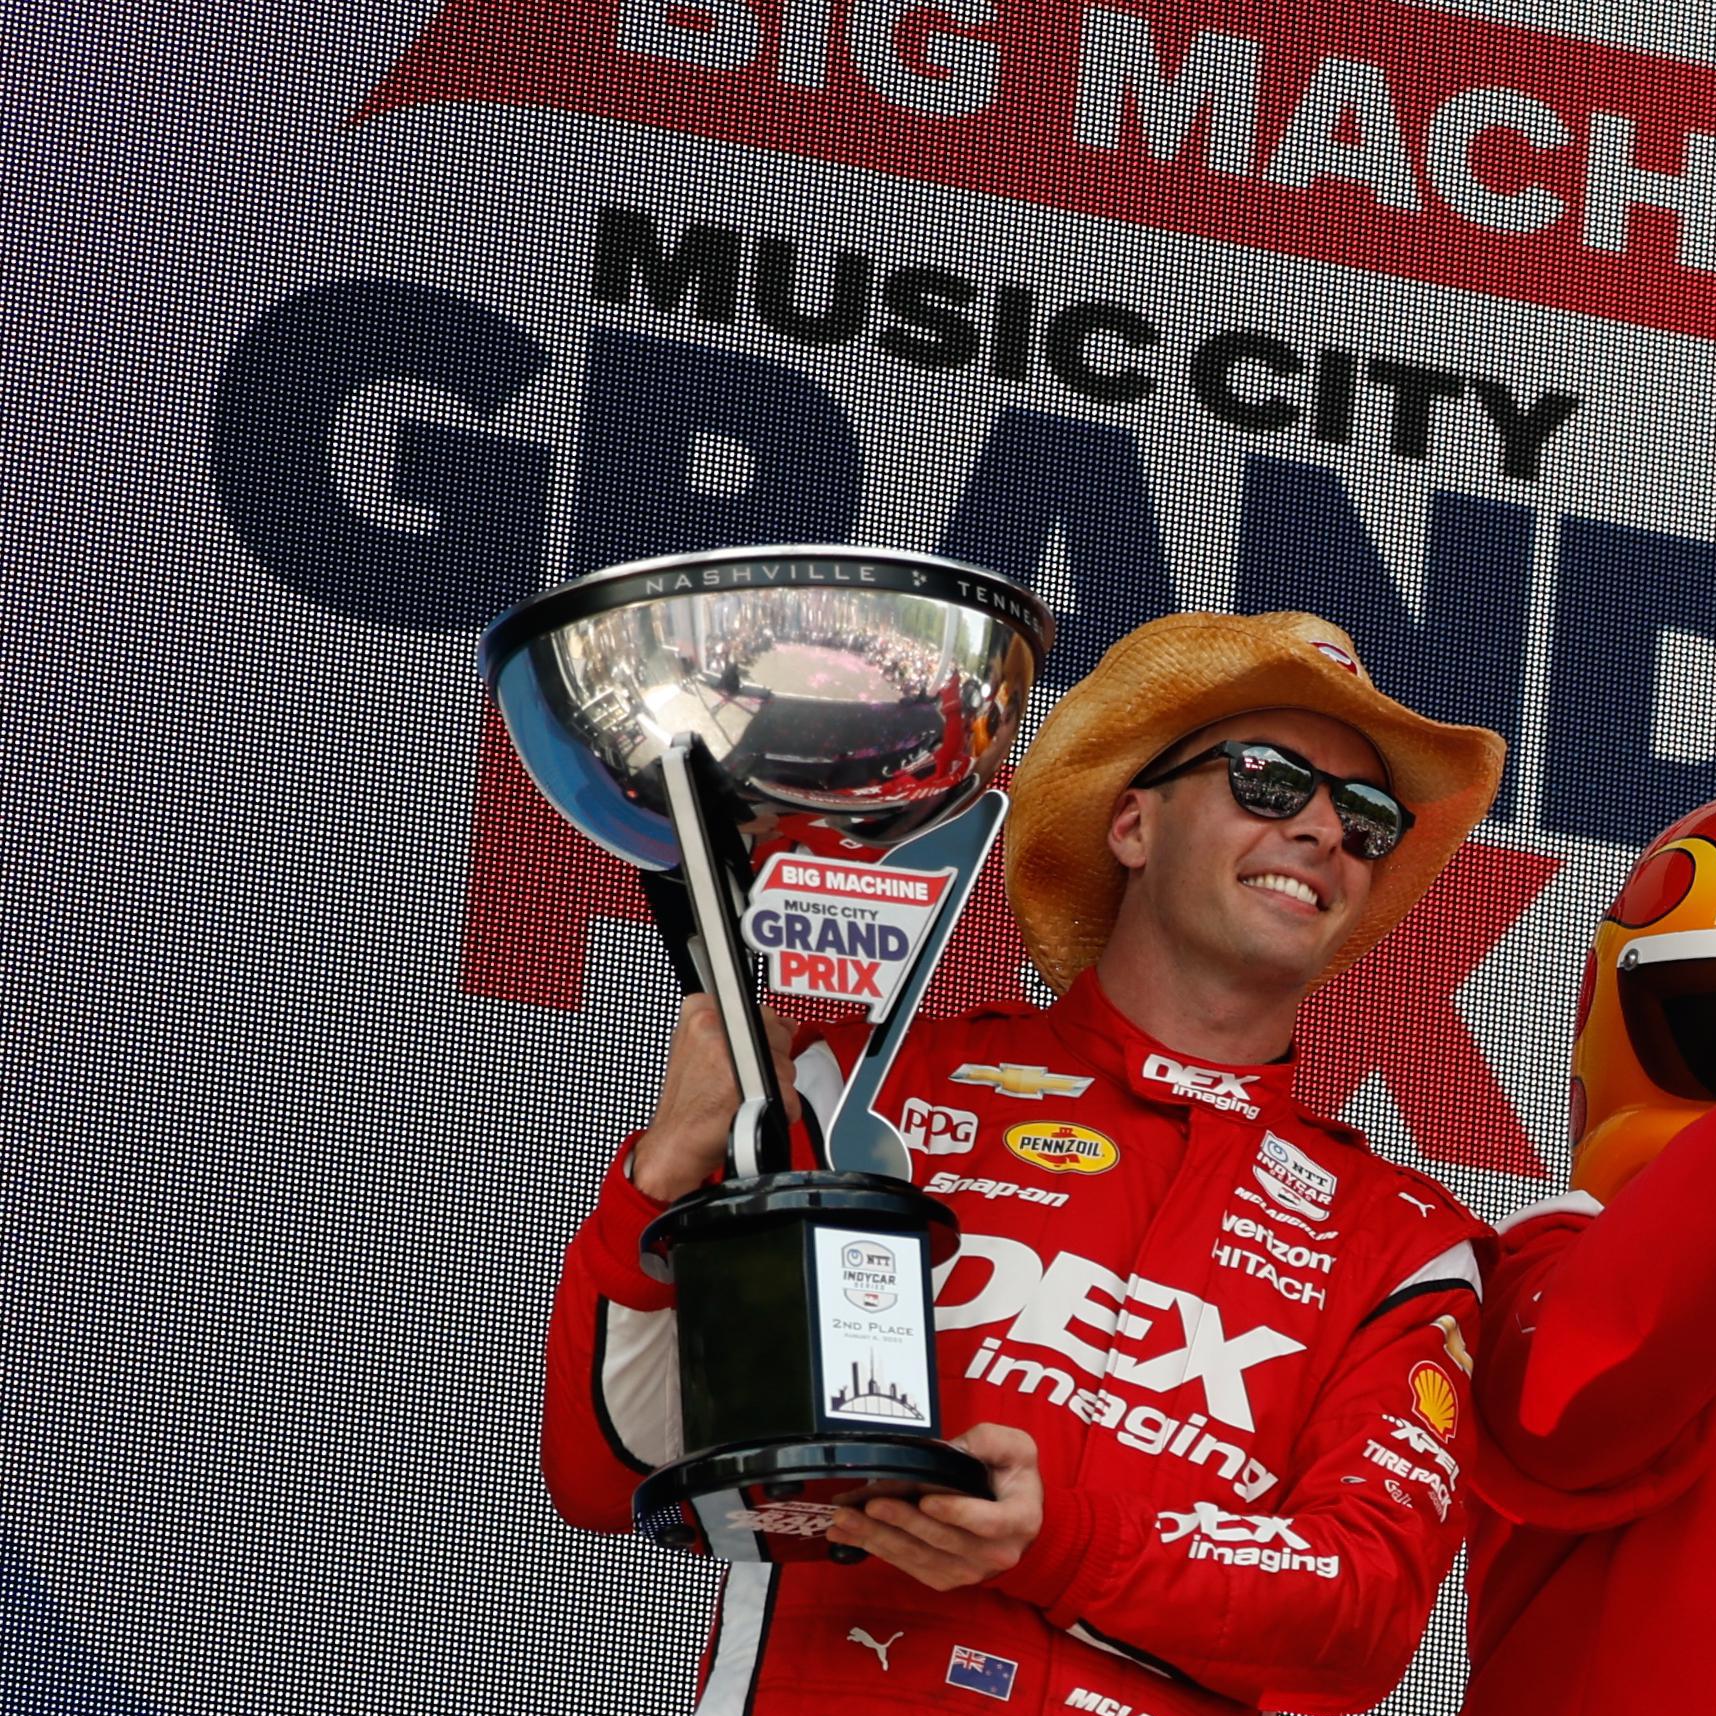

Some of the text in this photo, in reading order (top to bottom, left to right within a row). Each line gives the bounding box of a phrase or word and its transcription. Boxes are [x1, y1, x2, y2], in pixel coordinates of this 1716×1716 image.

[592, 206, 1581, 480] MUSIC CITY
[645, 565, 877, 596] NASHVILLE
[782, 865, 929, 901] BIG MACHINE
[784, 900, 880, 921] MUSIC CITY
[752, 909, 909, 962] GRAND
[779, 950, 884, 998] PRIX
[1142, 1053, 1262, 1101] DEX
[1171, 1083, 1261, 1120] imaging
[903, 1107, 975, 1150] PPG
[1019, 1136, 1102, 1158] PENNZOIL
[922, 1172, 1070, 1208] Snap-on
[1256, 1151, 1334, 1206] INDYCAR
[1291, 1160, 1329, 1187] NTT
[1221, 1208, 1334, 1275] verizon
[843, 1270, 897, 1285] INDYCAR
[934, 1233, 1307, 1433] DEX
[963, 1336, 1279, 1503] imaging
[1362, 1438, 1413, 1479] TIRE
[1187, 1534, 1340, 1579] imaging
